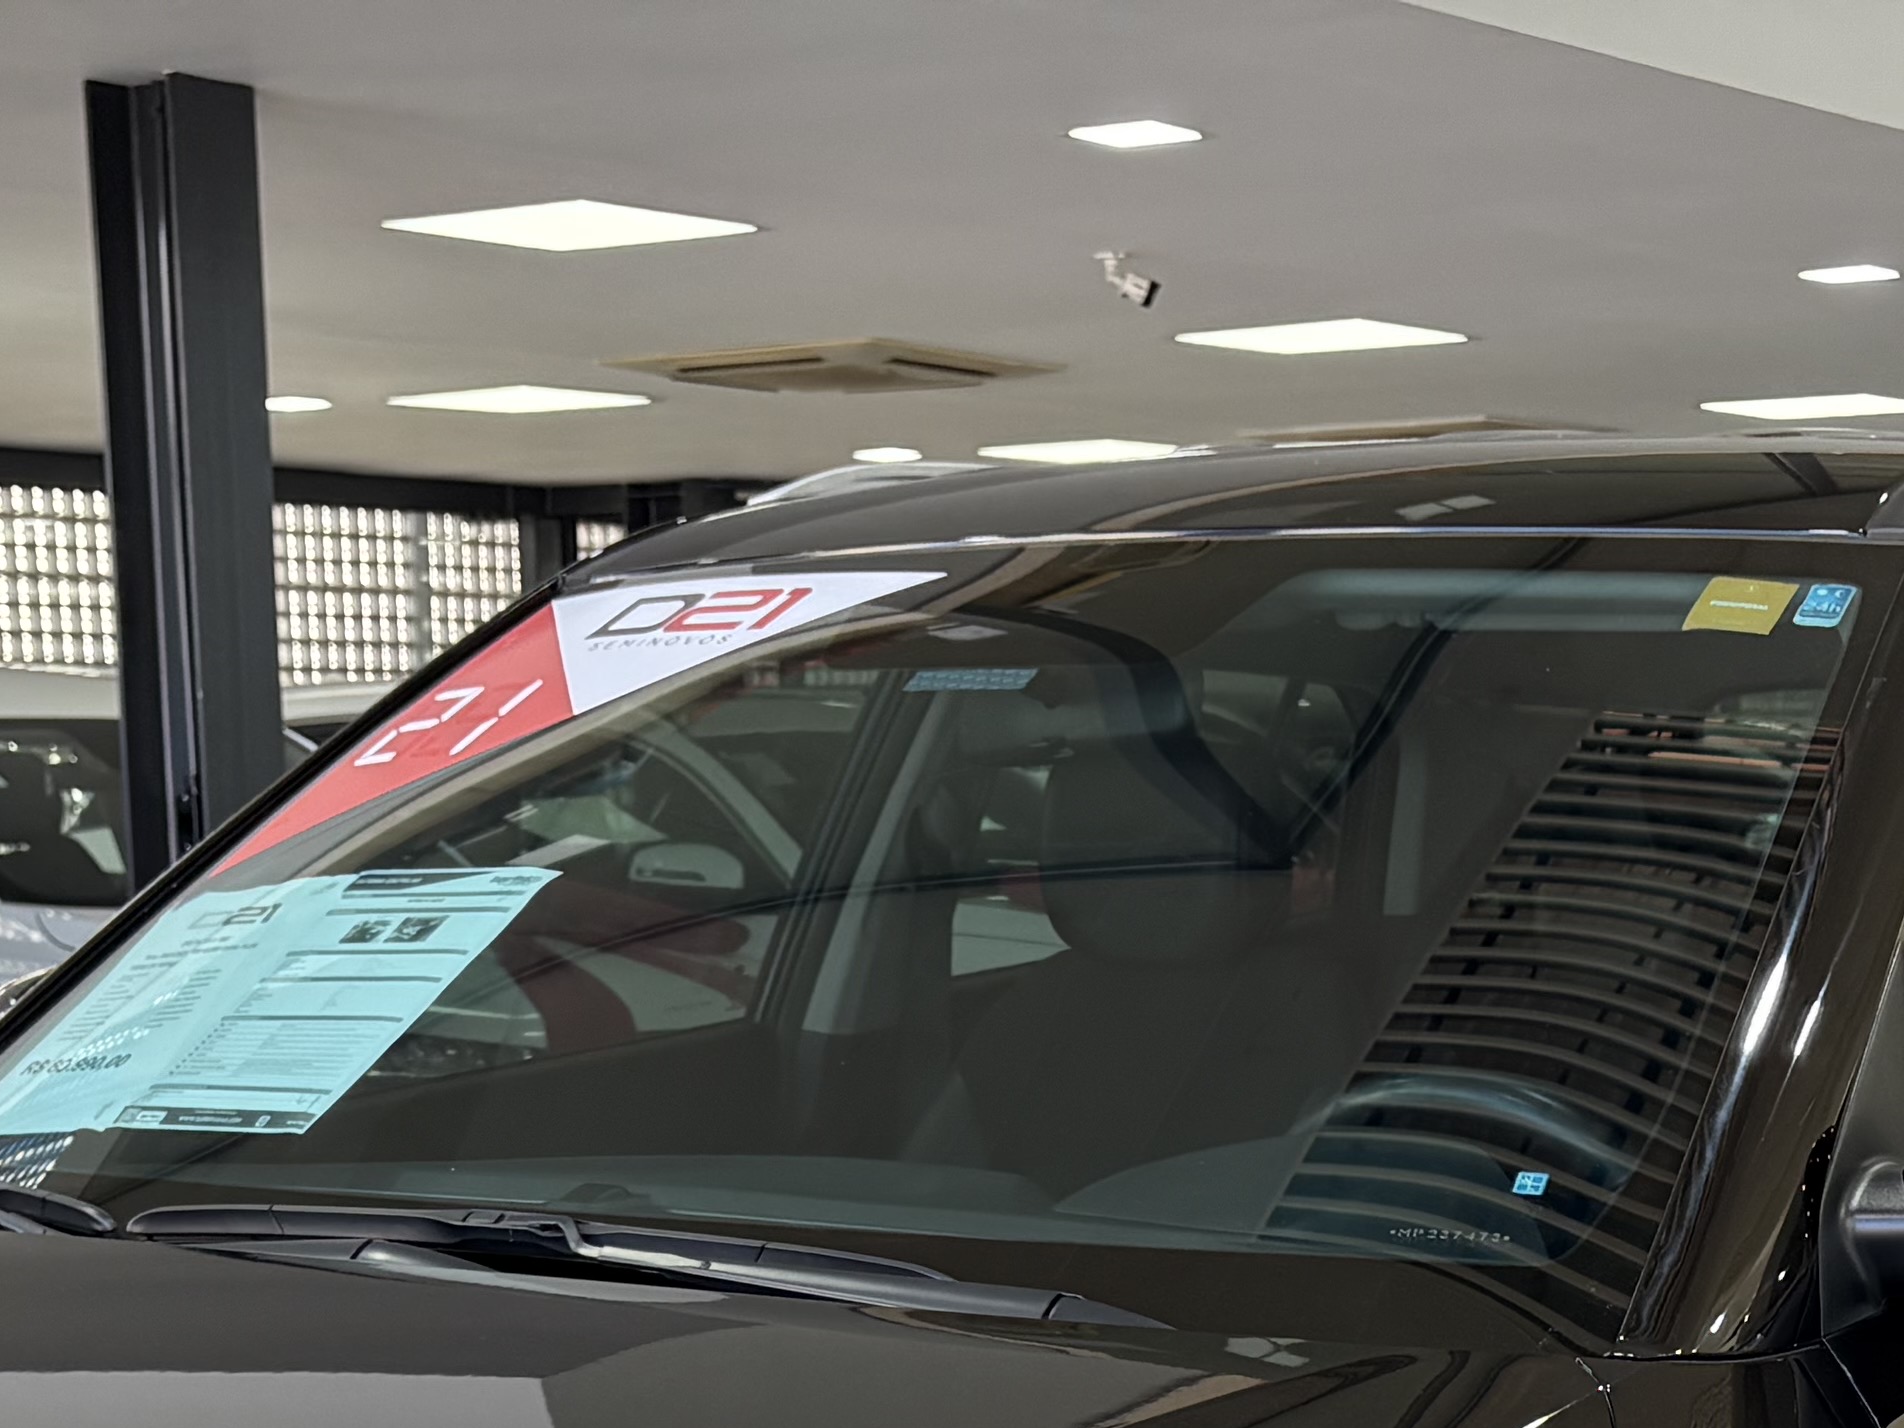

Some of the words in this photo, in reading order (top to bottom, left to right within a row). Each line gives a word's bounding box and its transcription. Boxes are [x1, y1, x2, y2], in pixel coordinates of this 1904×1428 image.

[584, 587, 813, 640] D21
[588, 633, 733, 652] SEMINOVOS
[187, 902, 283, 930] D21
